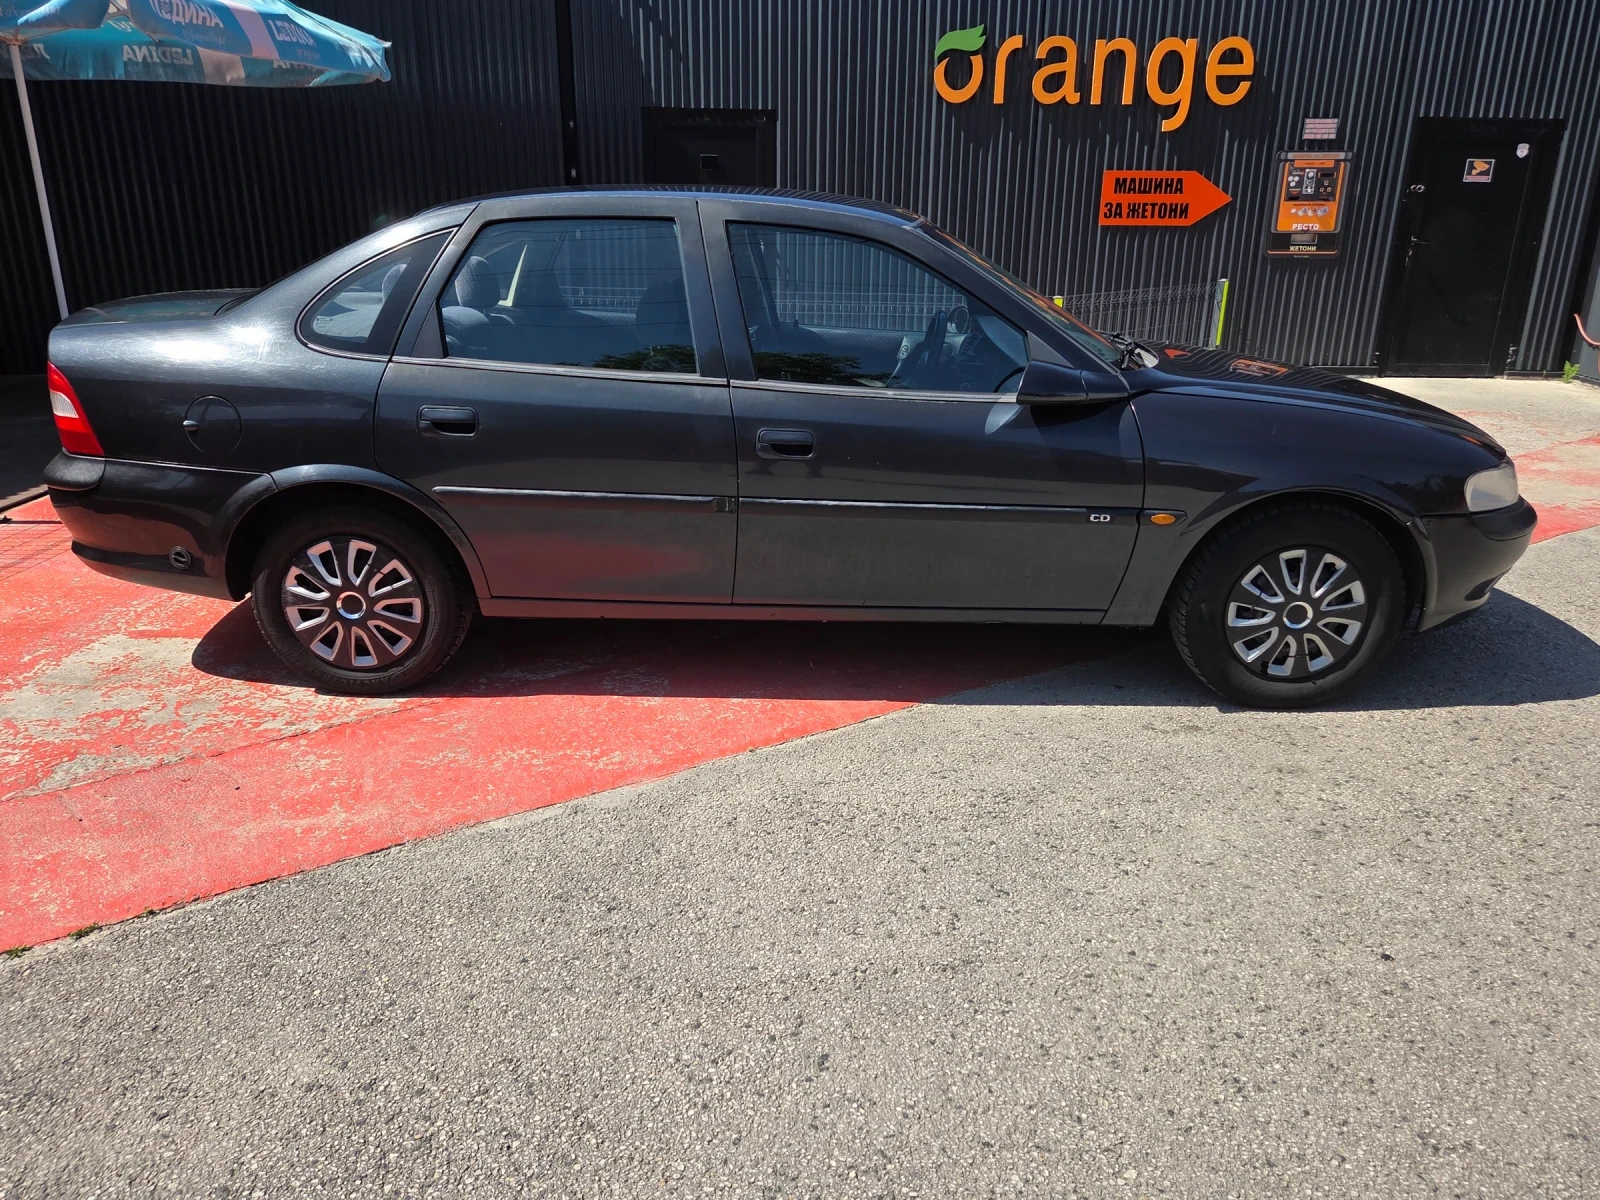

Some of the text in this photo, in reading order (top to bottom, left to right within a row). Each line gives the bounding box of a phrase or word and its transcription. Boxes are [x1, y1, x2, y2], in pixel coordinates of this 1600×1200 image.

[268, 19, 317, 48] LEDINA
[934, 33, 1255, 132] orange
[1113, 177, 1184, 195] МАШИНА
[1103, 202, 1189, 220] ЗА ЖЕТОНИ
[1292, 223, 1320, 231] РЕСТО
[1089, 513, 1111, 522] CD
